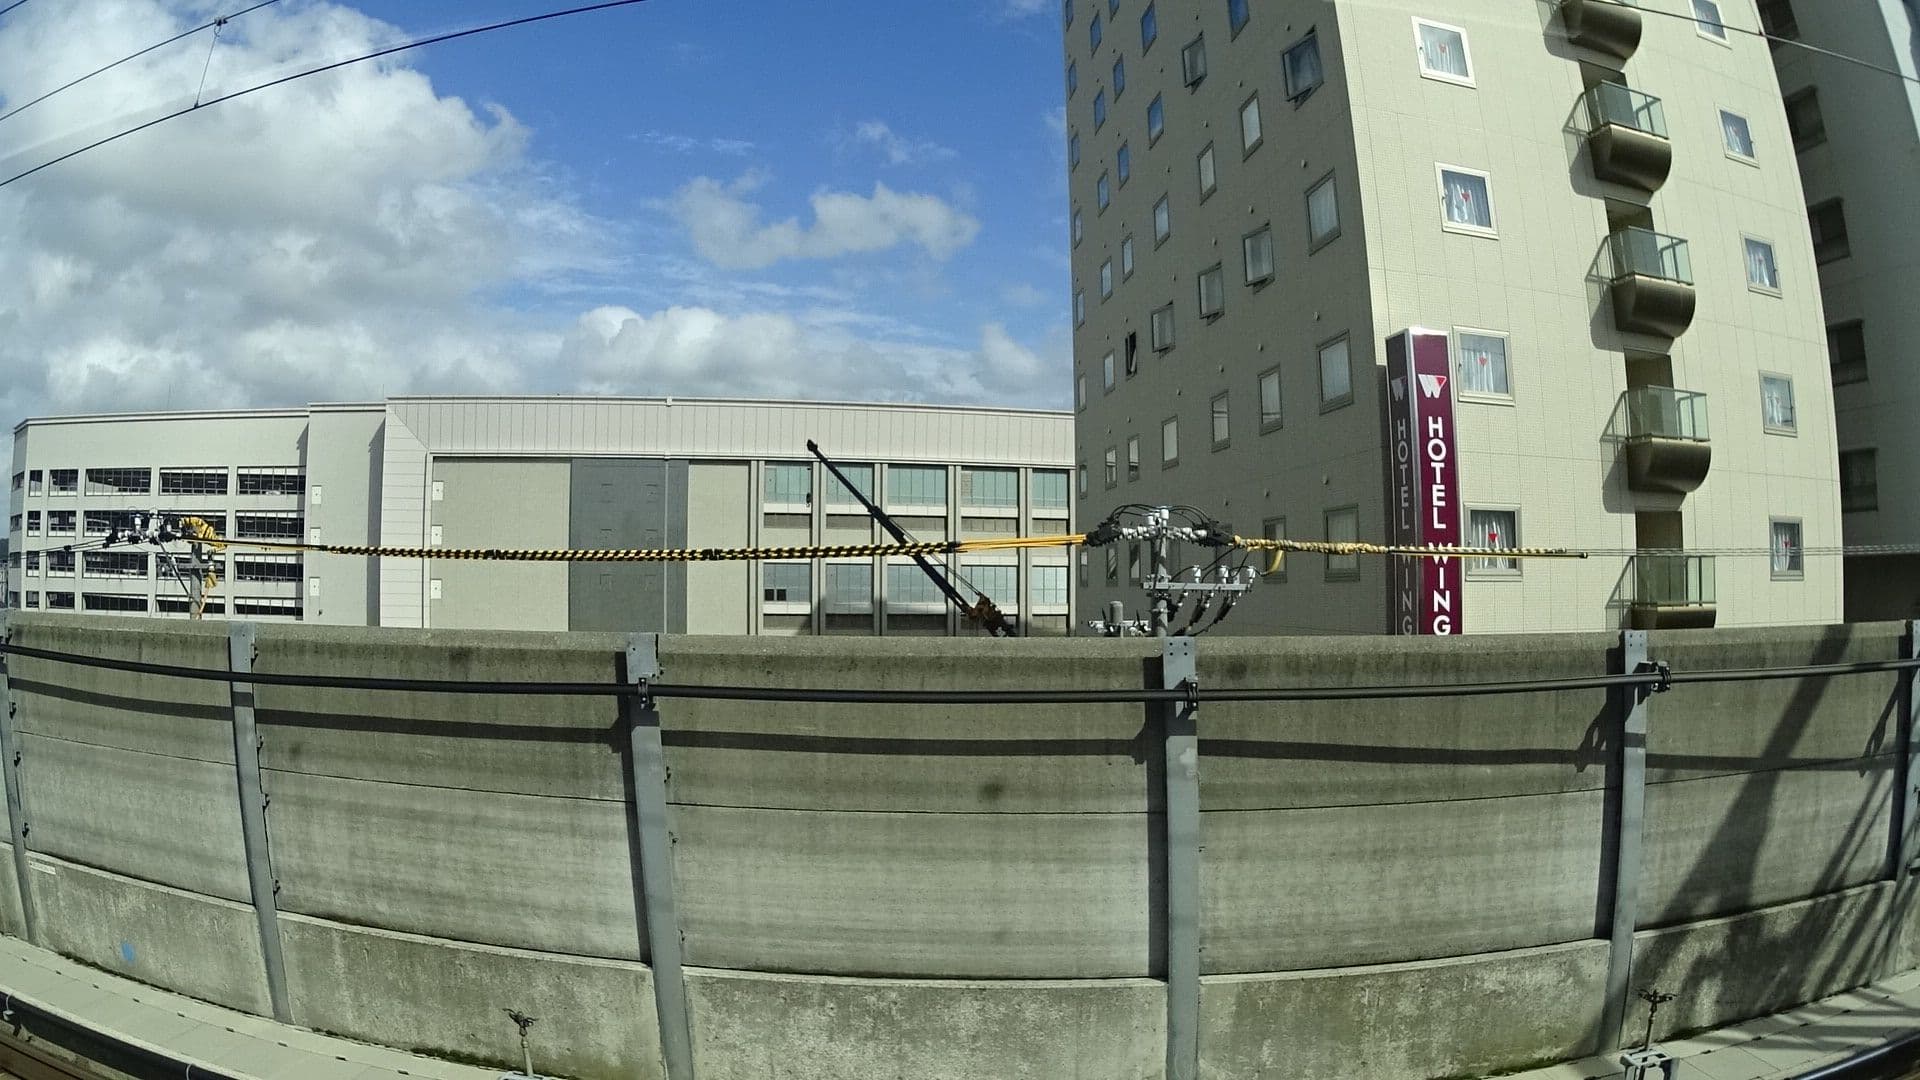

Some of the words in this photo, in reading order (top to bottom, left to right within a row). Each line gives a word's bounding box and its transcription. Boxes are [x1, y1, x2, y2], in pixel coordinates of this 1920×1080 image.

[1397, 418, 1409, 529] HOTEL
[1427, 416, 1446, 529] HOTEL
[1428, 542, 1452, 635] WING
